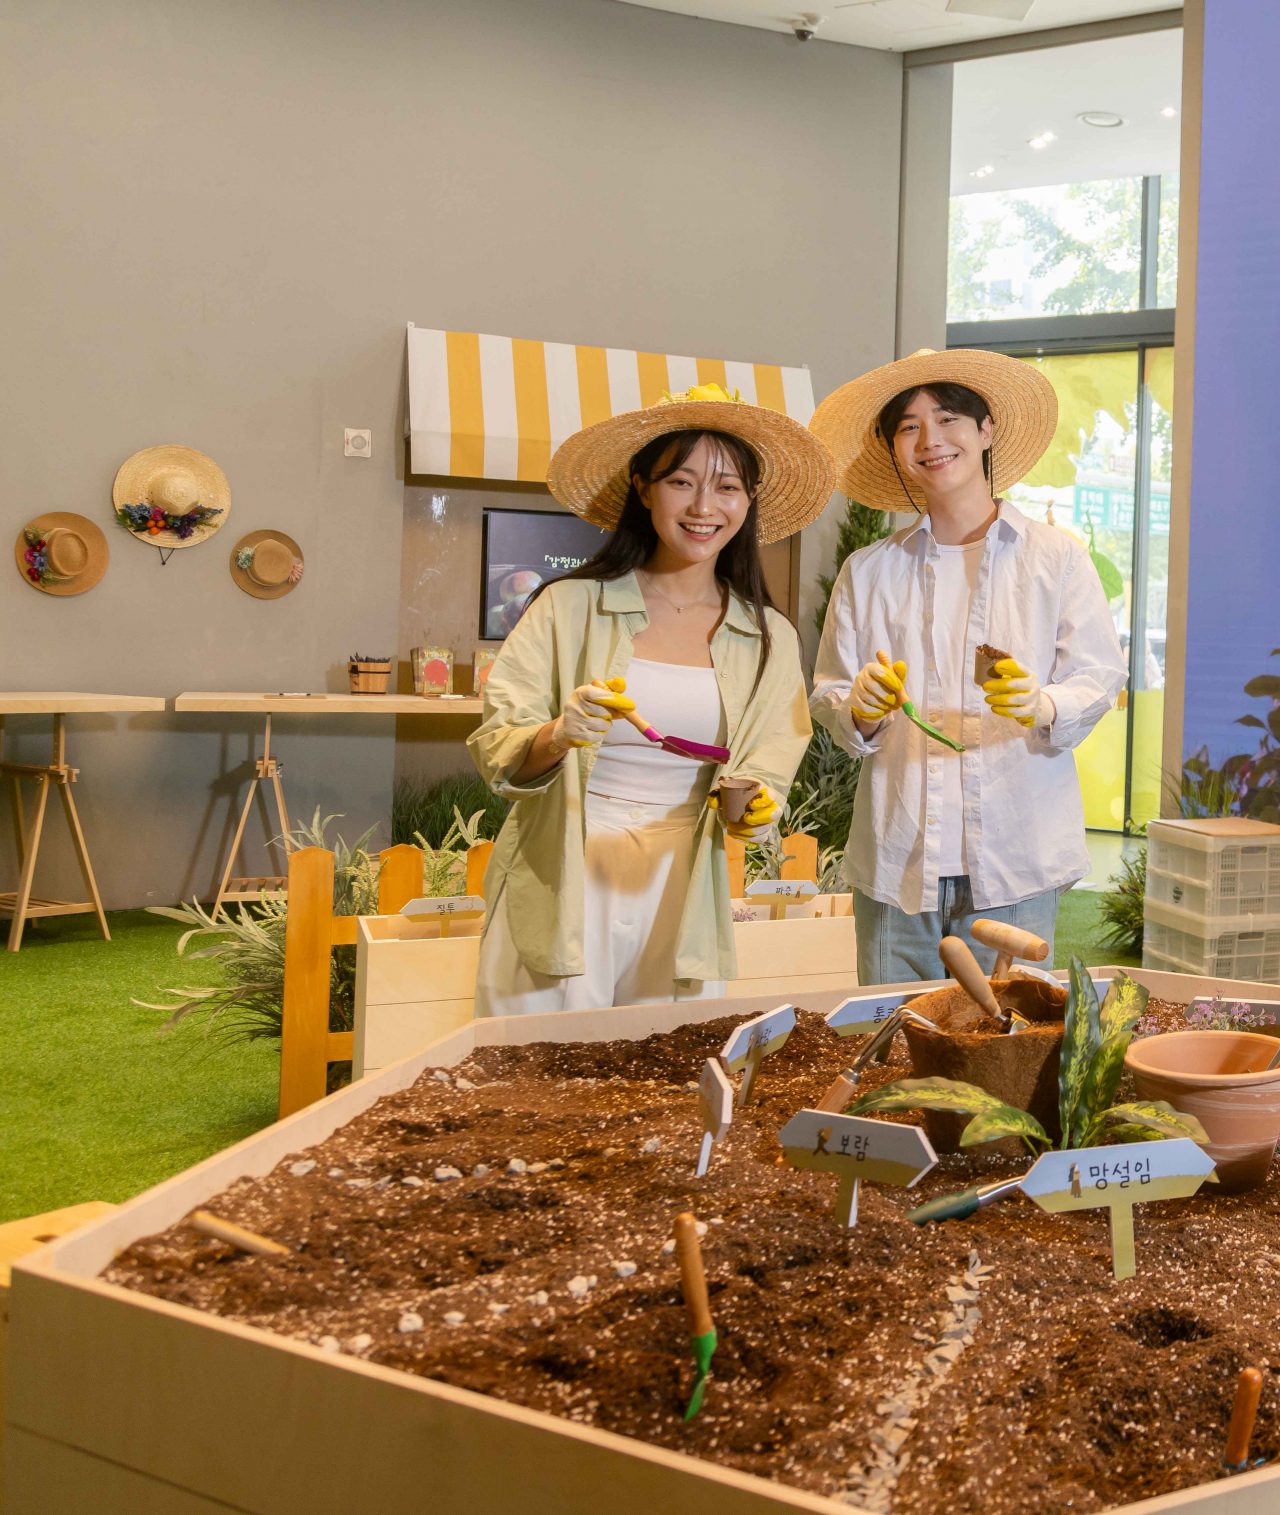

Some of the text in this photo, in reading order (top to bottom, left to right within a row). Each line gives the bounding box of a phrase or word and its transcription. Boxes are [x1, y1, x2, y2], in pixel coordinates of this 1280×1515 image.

[436, 902, 455, 918] 질투
[840, 1134, 870, 1162] 보람
[1089, 1157, 1151, 1190] 망설임
